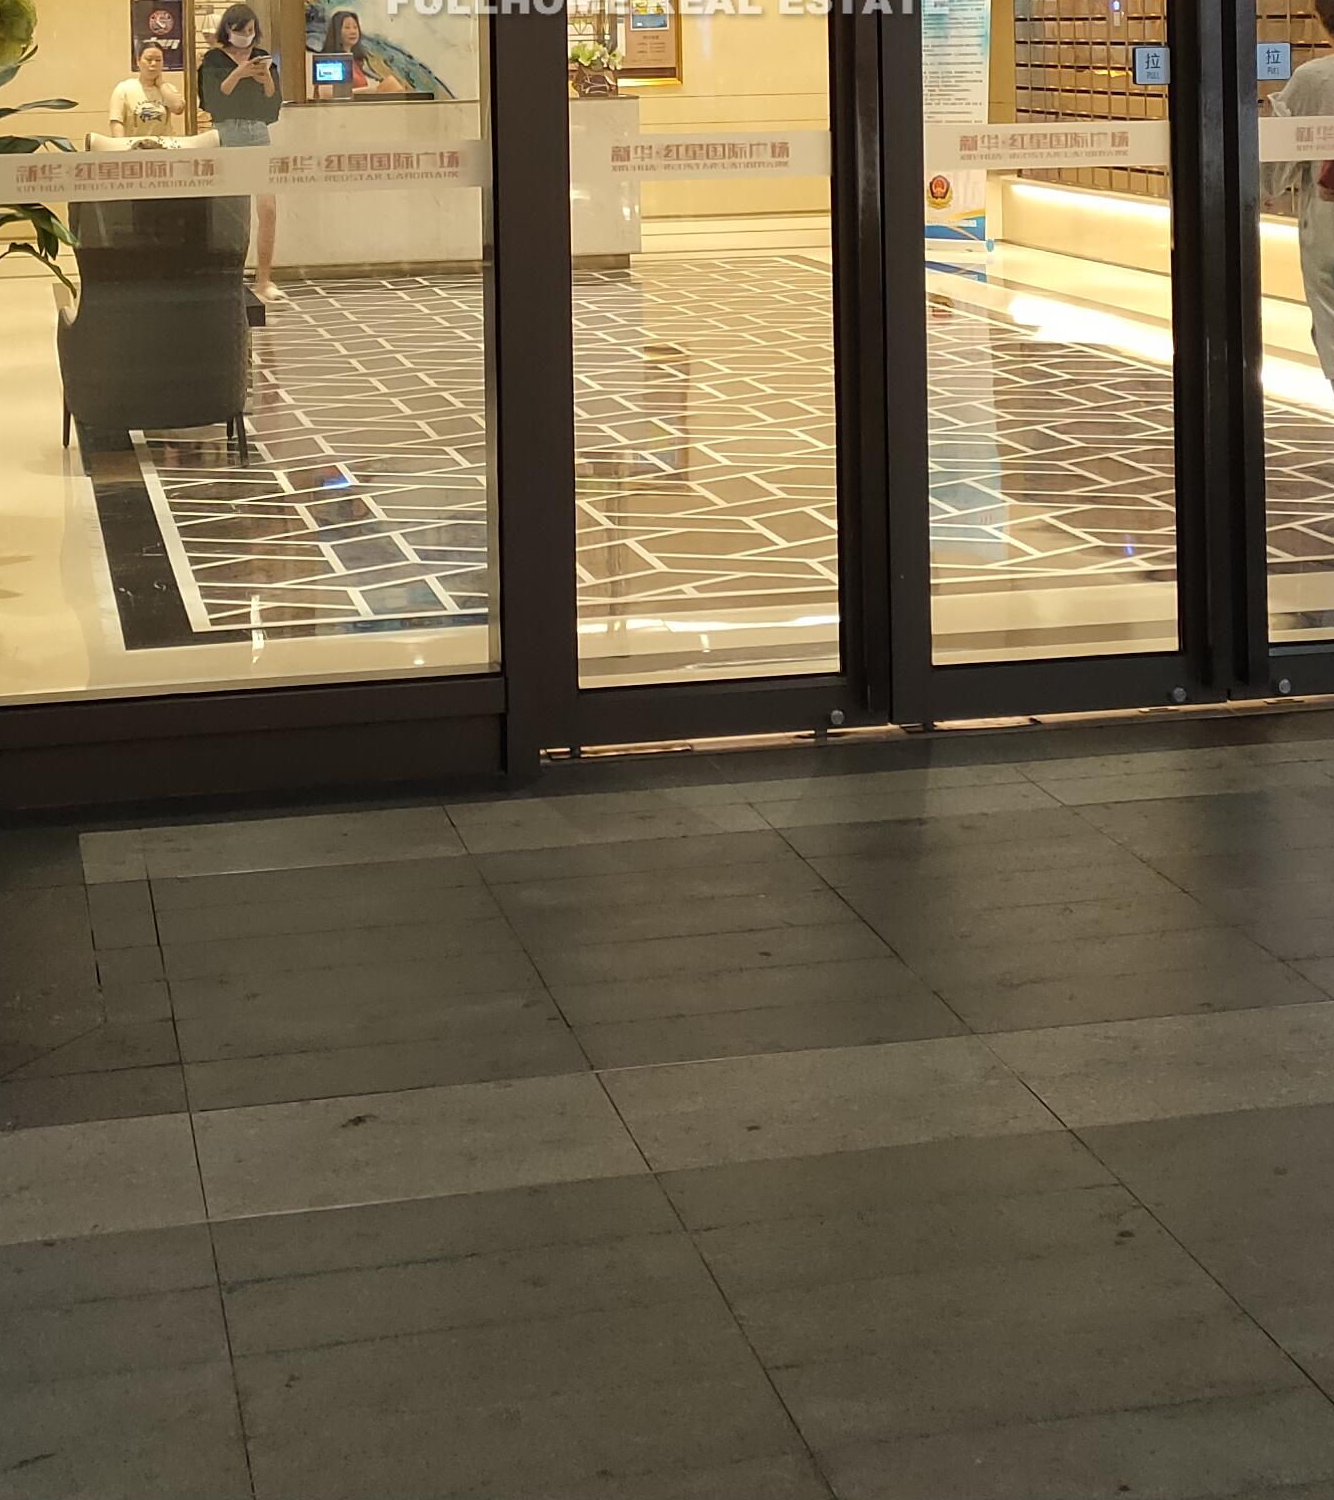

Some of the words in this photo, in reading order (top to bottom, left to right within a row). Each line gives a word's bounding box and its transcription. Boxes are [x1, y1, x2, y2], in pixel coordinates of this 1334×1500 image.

[1145, 52, 1161, 70] 拉
[1265, 49, 1282, 65] 拉
[1146, 72, 1160, 80] PULL
[1267, 67, 1280, 76] PULL
